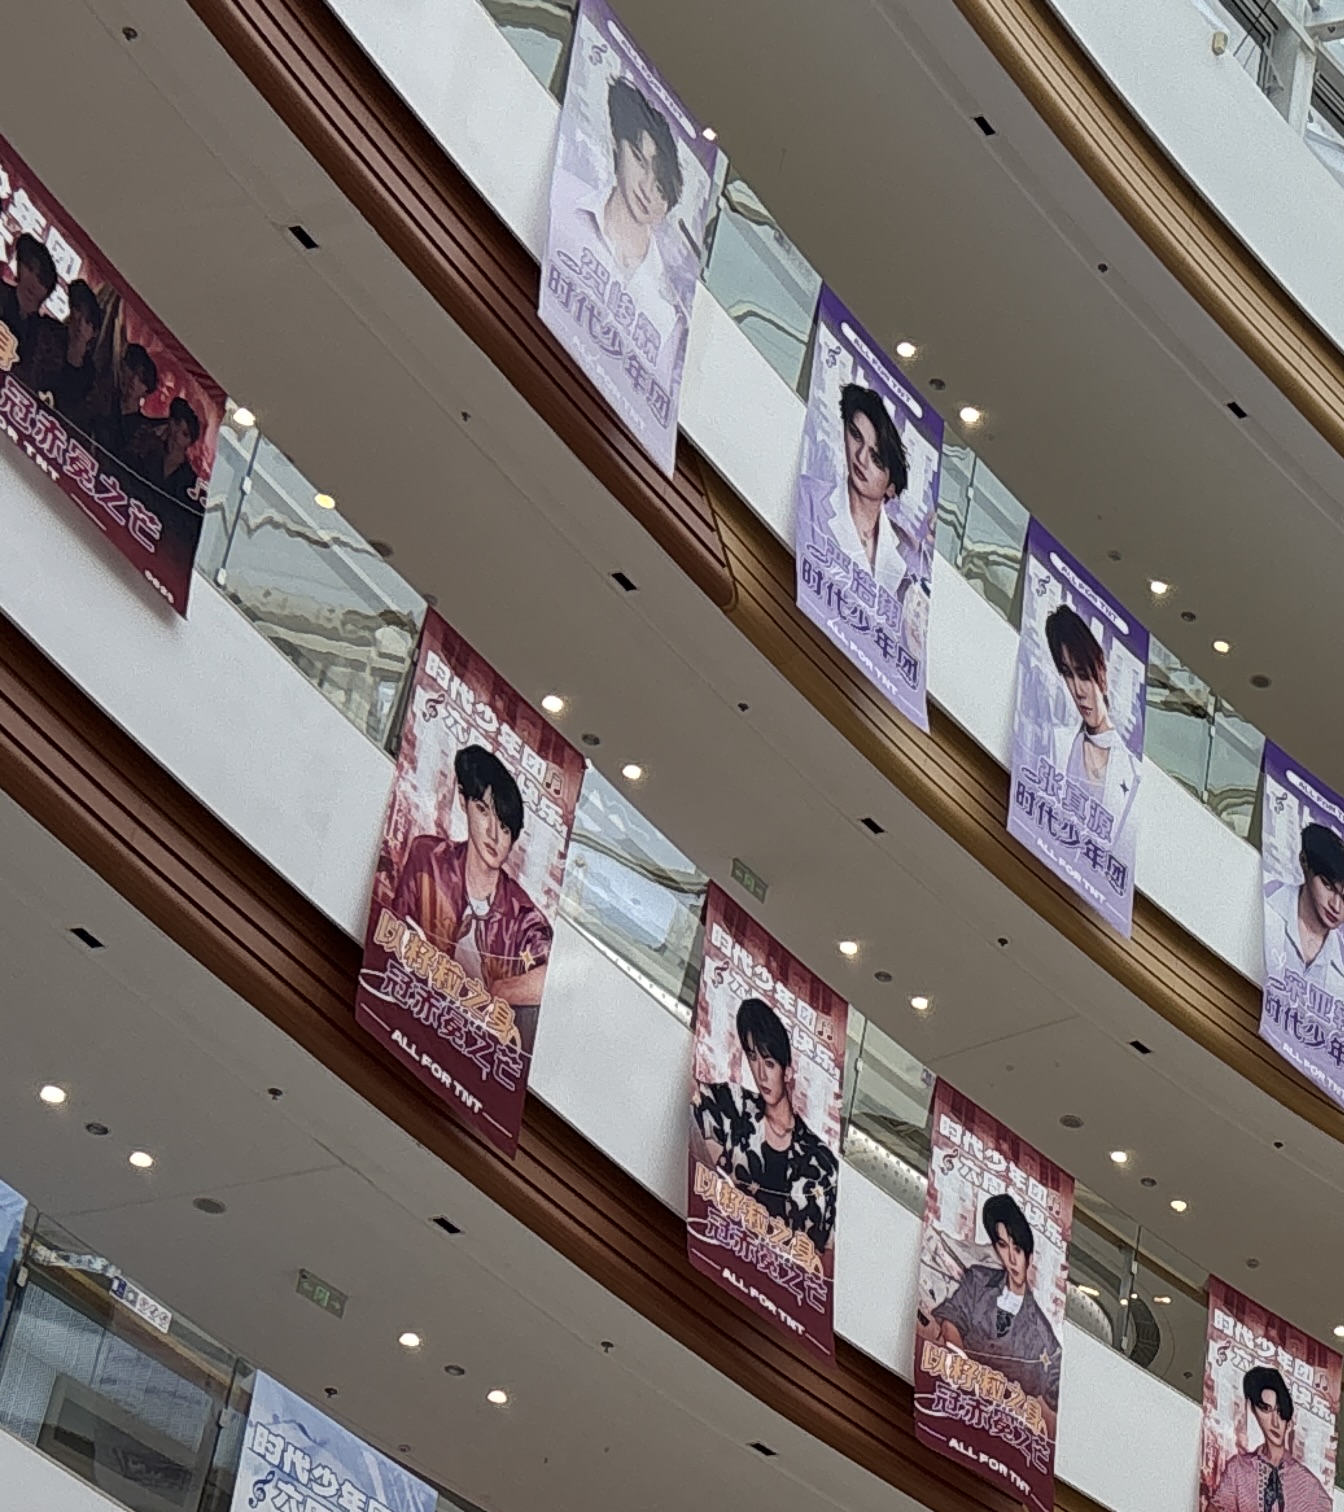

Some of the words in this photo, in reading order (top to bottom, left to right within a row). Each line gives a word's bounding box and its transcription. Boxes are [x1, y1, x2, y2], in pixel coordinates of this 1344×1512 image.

[548, 257, 670, 429] 时代少年团
[24, 439, 61, 482] TNT
[802, 554, 918, 689] 时代少年团
[426, 651, 546, 785] 时代少年团
[1017, 780, 1126, 897] 时代少年团
[713, 924, 815, 1033] 时代少年团
[392, 1027, 421, 1062] ALL
[421, 1053, 451, 1089] FOR
[452, 1081, 482, 1117] TNT
[940, 1112, 1046, 1208] 时代少年团
[1215, 1308, 1314, 1390] 时代少年团
